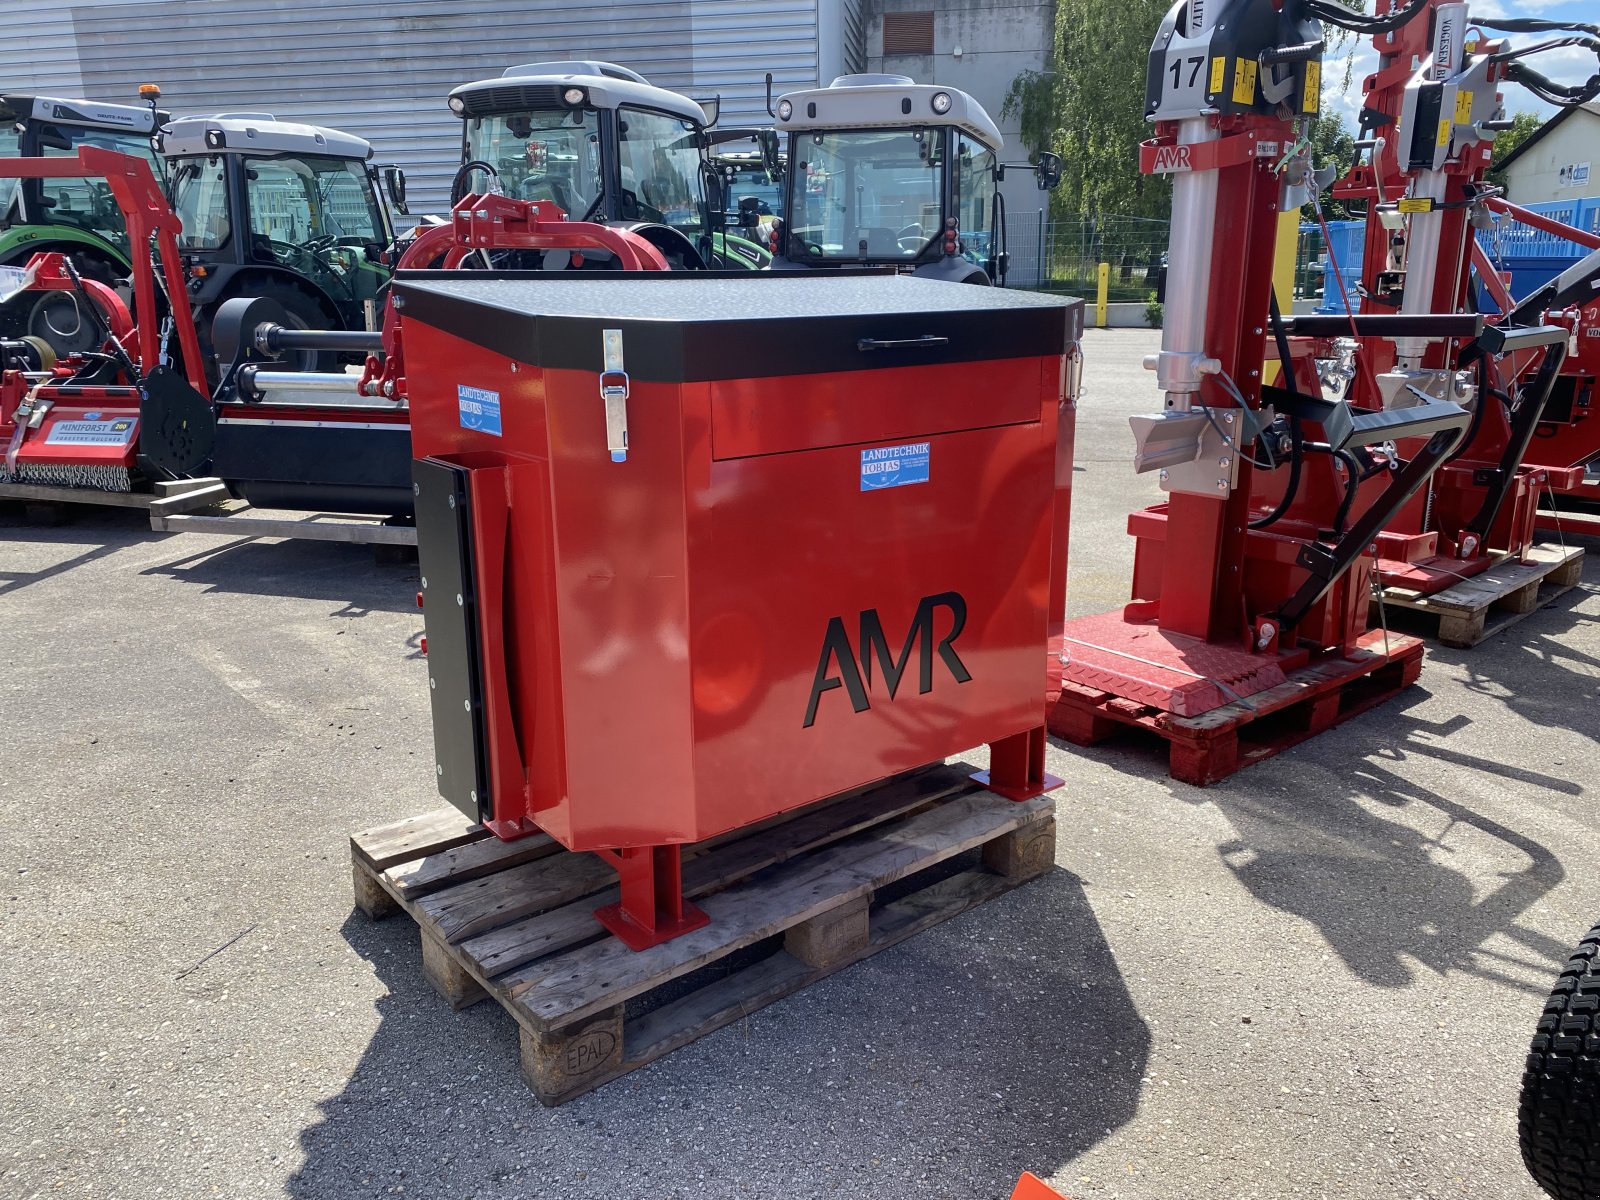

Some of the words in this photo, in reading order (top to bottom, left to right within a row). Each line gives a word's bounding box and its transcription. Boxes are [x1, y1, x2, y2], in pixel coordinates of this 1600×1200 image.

[1192, 0, 1204, 29] LITZ
[1438, 19, 1452, 63] VOGESEN
[1169, 56, 1205, 89] 17
[1154, 146, 1191, 170] AMR
[458, 385, 499, 404] LANDTECHNIK
[460, 400, 482, 415] TOBIAS
[60, 423, 108, 432] MINIFORST
[862, 443, 929, 462] LANDTECHNIK
[864, 460, 899, 474] TOBIAS
[803, 591, 973, 729] AMR
[566, 1038, 608, 1070] EPAL
